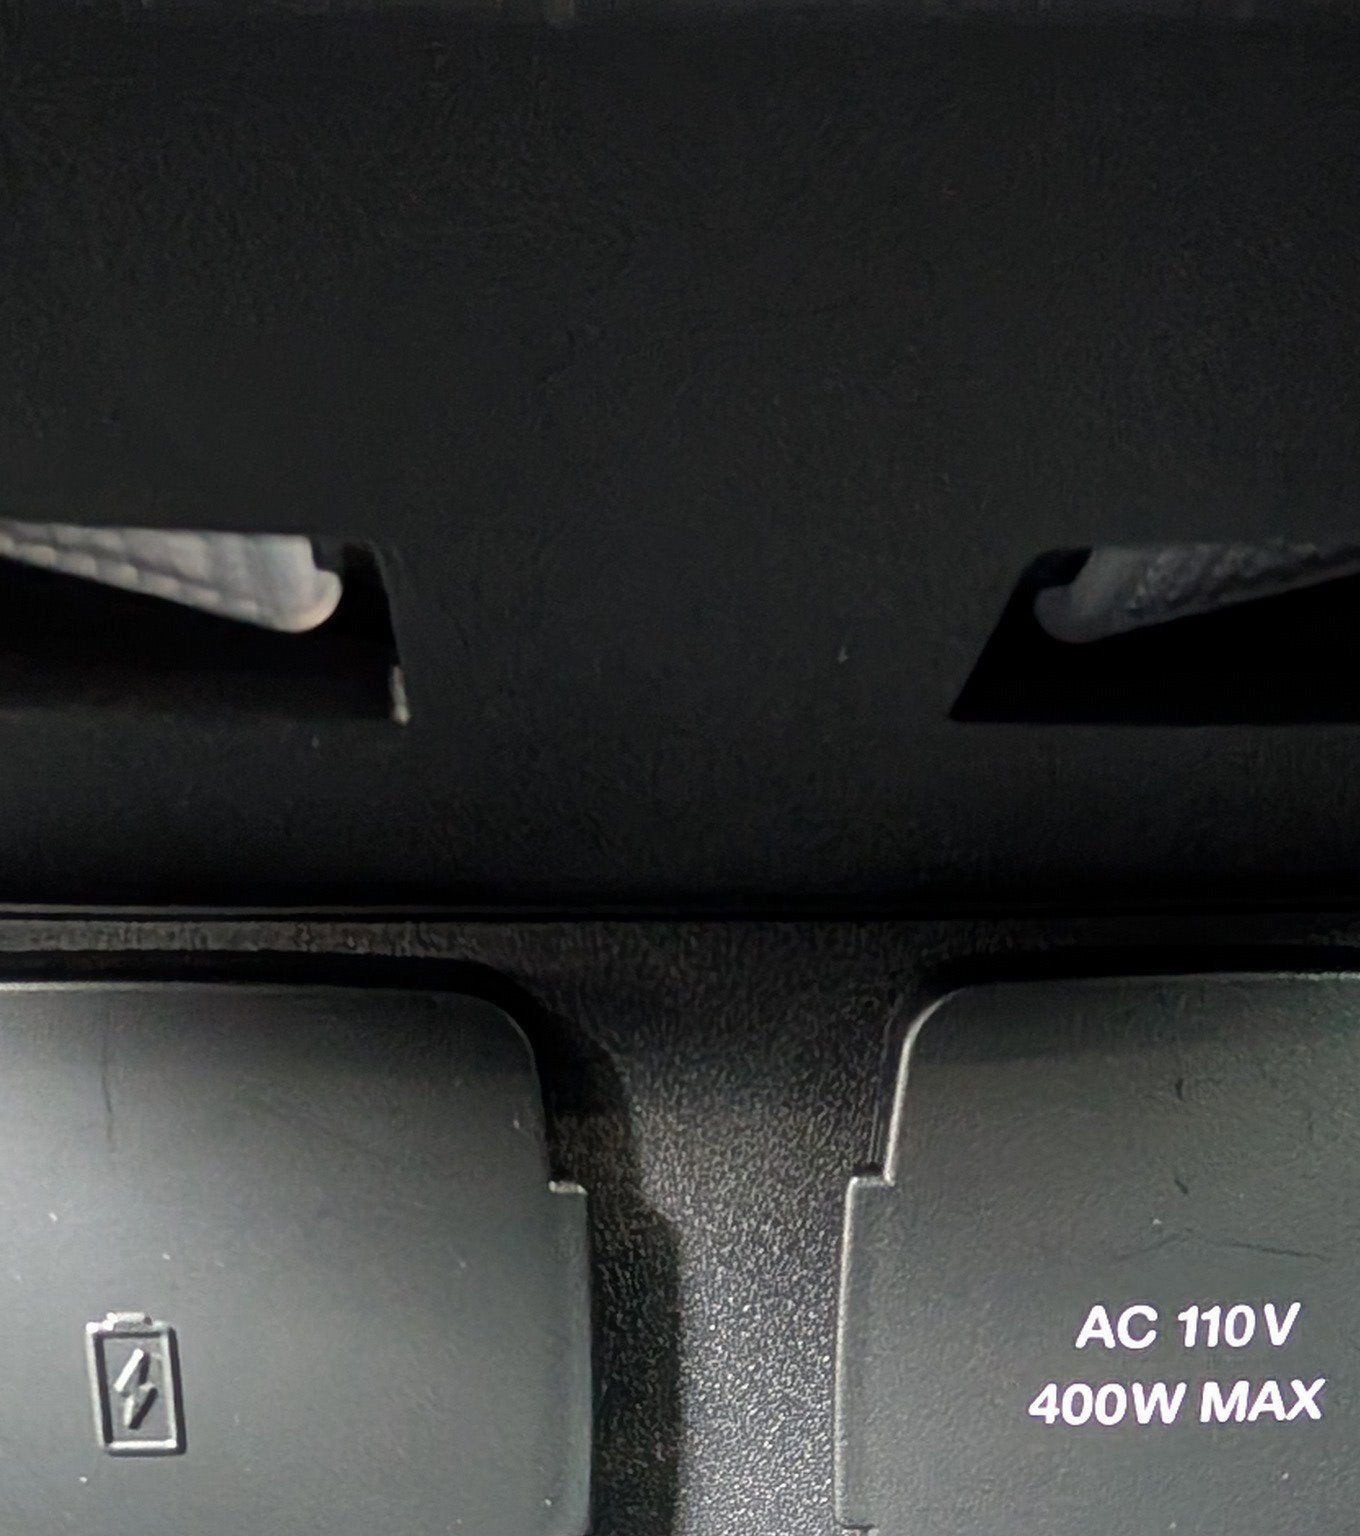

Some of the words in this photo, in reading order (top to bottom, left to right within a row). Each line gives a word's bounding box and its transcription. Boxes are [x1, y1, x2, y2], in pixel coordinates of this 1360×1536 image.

[1075, 1304, 1159, 1350] AC
[1177, 1301, 1302, 1349] 110V
[1027, 1381, 1187, 1427] 400W
[1199, 1377, 1327, 1424] MAX
